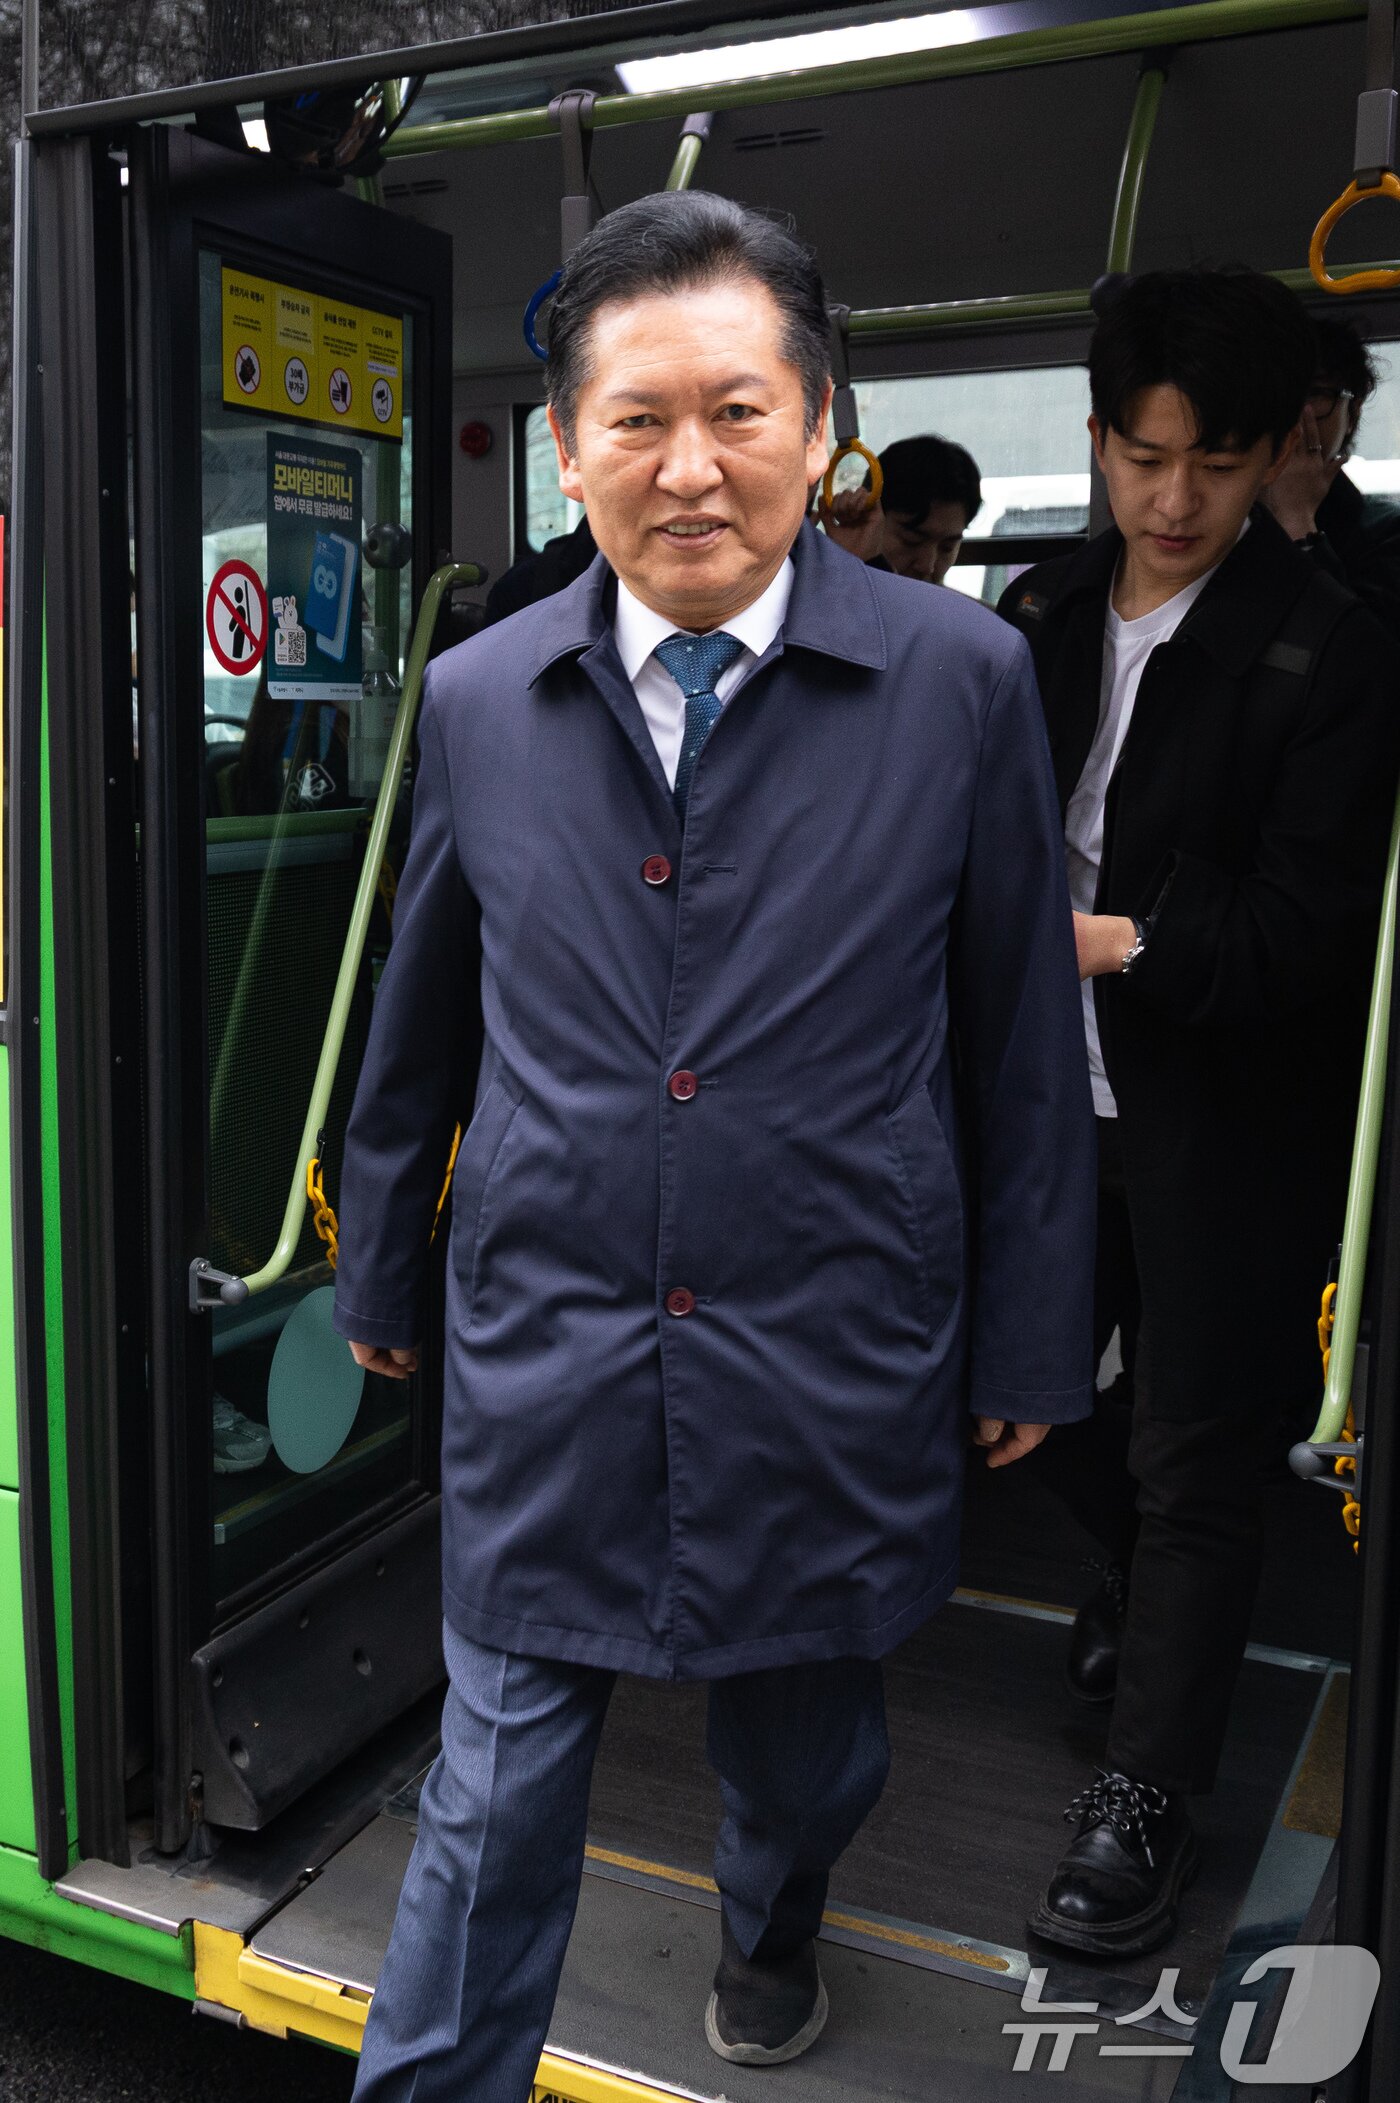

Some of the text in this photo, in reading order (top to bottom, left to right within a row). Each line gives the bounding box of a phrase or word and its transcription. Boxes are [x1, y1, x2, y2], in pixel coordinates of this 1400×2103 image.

[290, 367, 303, 380] 30배
[288, 381, 305, 395] 부가금
[274, 464, 353, 503] 모바일티머니
[273, 495, 353, 521] 앱에서 무료 발급하세요!
